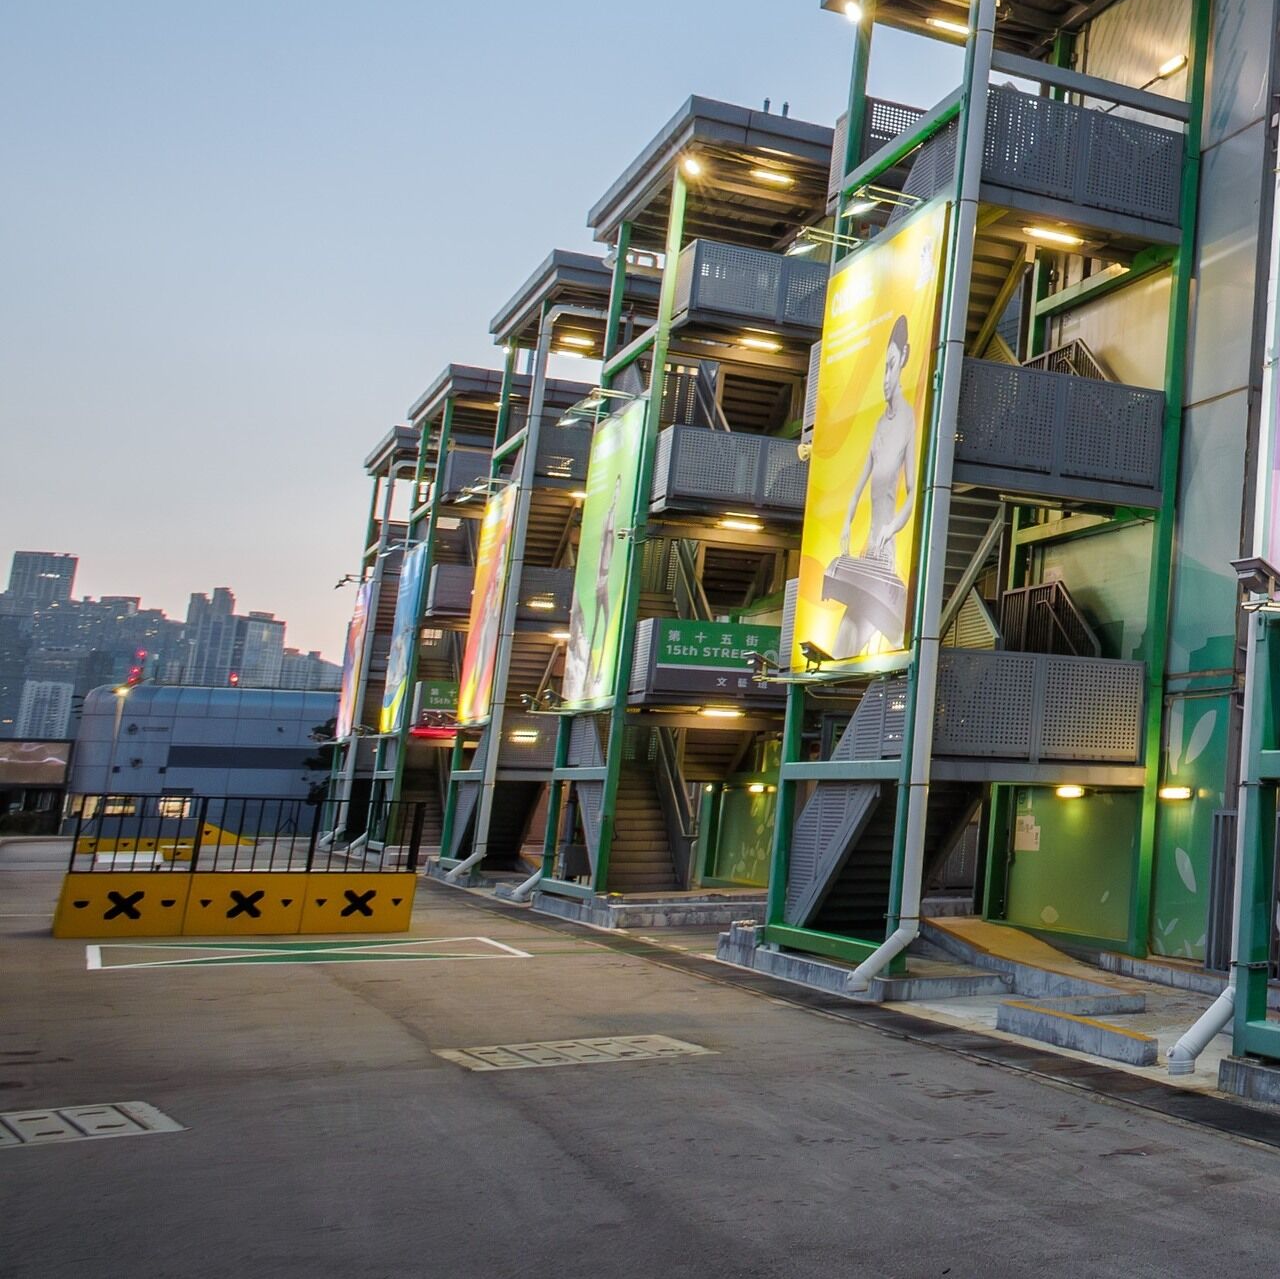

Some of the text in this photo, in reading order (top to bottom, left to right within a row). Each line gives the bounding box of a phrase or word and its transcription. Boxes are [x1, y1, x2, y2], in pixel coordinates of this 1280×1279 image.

[668, 629, 759, 647] 第十五街
[666, 645, 698, 656] 15th
[703, 647, 755, 659] STREE
